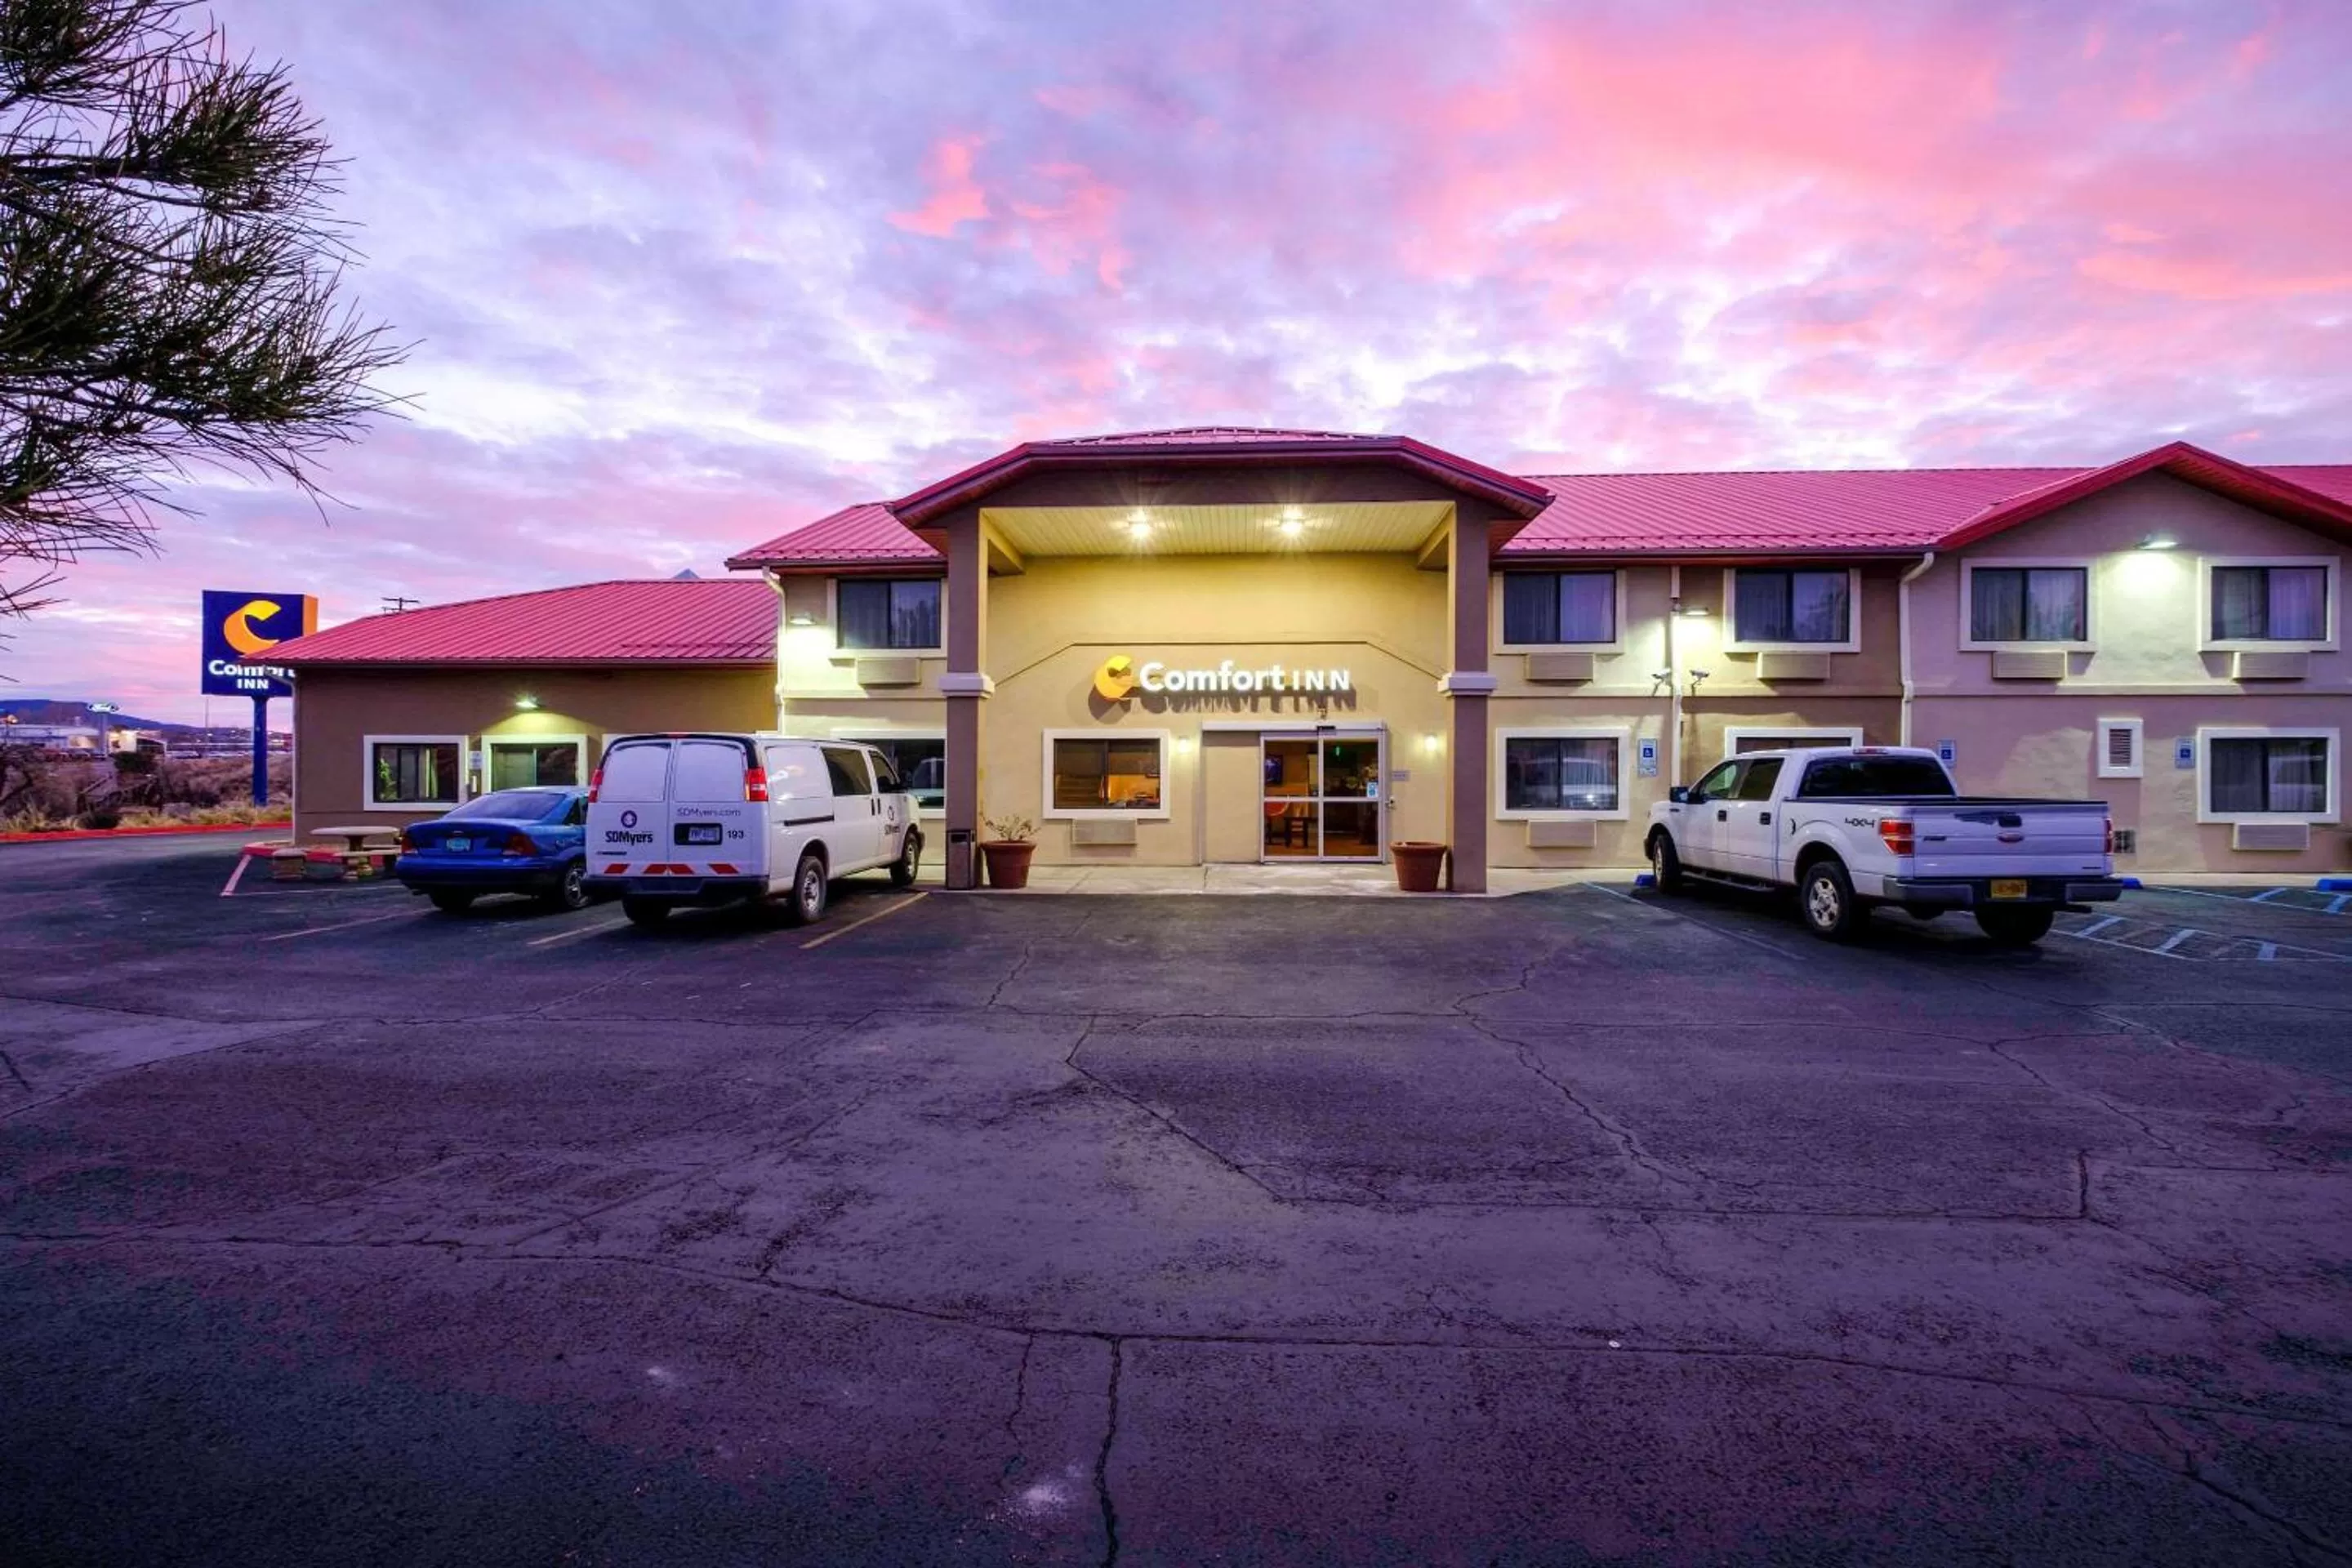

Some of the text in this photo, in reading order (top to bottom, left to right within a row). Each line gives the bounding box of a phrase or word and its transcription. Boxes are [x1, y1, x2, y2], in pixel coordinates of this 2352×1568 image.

[1139, 660, 1286, 692] Comfort
[1293, 663, 1350, 691] INN
[236, 679, 270, 689] INN
[605, 831, 653, 846] SDMyers
[726, 830, 745, 840] 193
